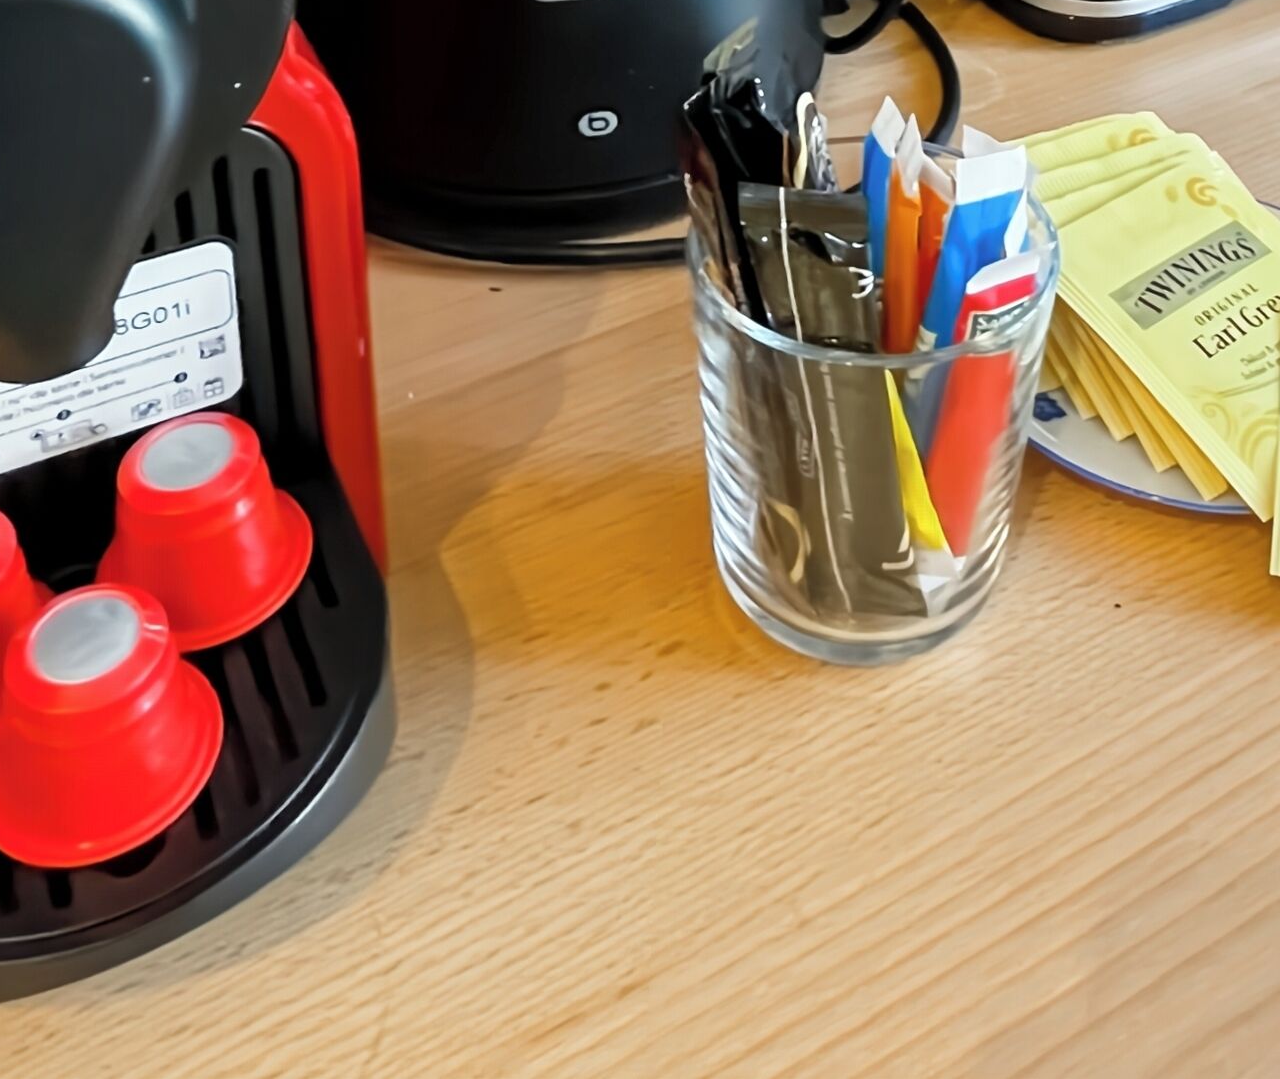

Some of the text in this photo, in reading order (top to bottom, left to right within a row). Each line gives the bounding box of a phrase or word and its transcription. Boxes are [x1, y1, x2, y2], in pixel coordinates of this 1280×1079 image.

[1134, 236, 1257, 314] TWININGS
[1194, 282, 1259, 326] ORIGINAL
[1192, 316, 1248, 359] Earl
